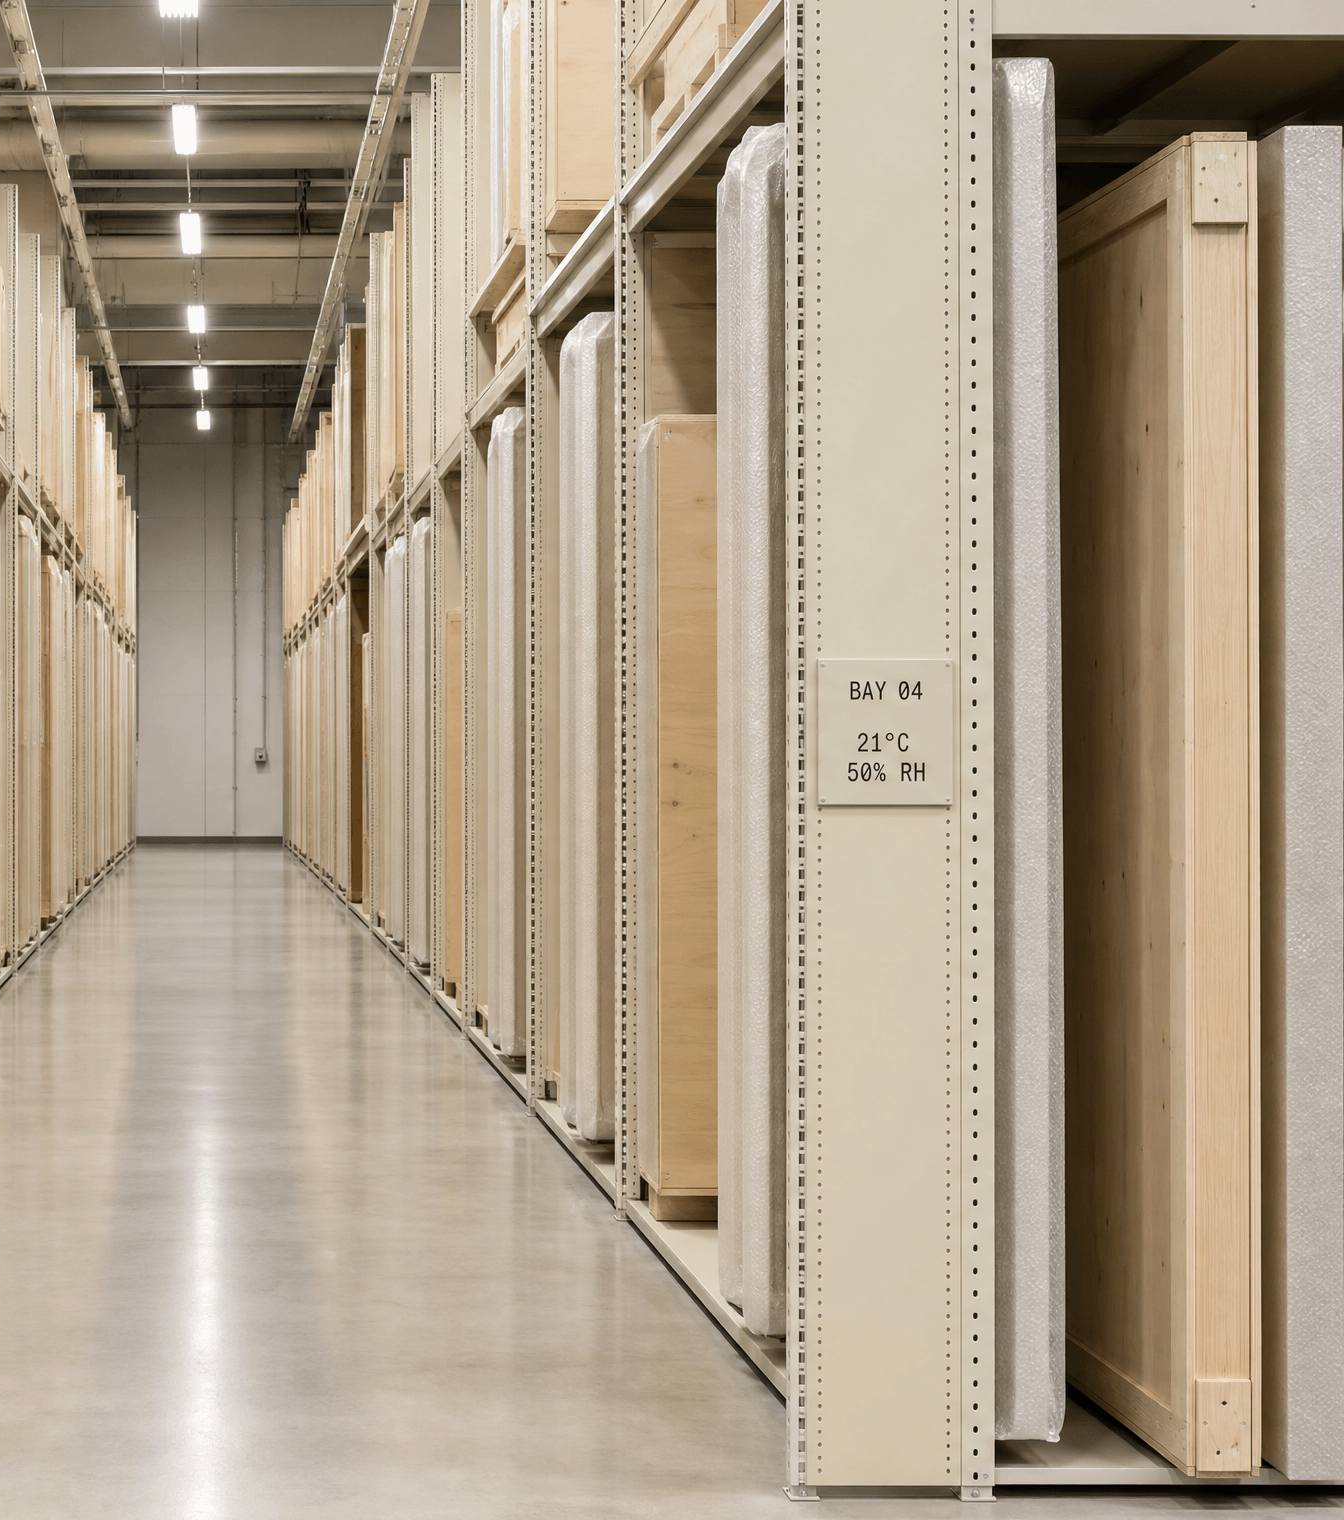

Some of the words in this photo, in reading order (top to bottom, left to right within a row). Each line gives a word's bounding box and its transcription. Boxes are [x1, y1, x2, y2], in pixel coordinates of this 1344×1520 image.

[849, 680, 887, 701] BAY
[898, 680, 923, 701] 04
[857, 732, 909, 753] 21°C
[847, 762, 887, 782] 50%
[900, 762, 926, 782] RH
